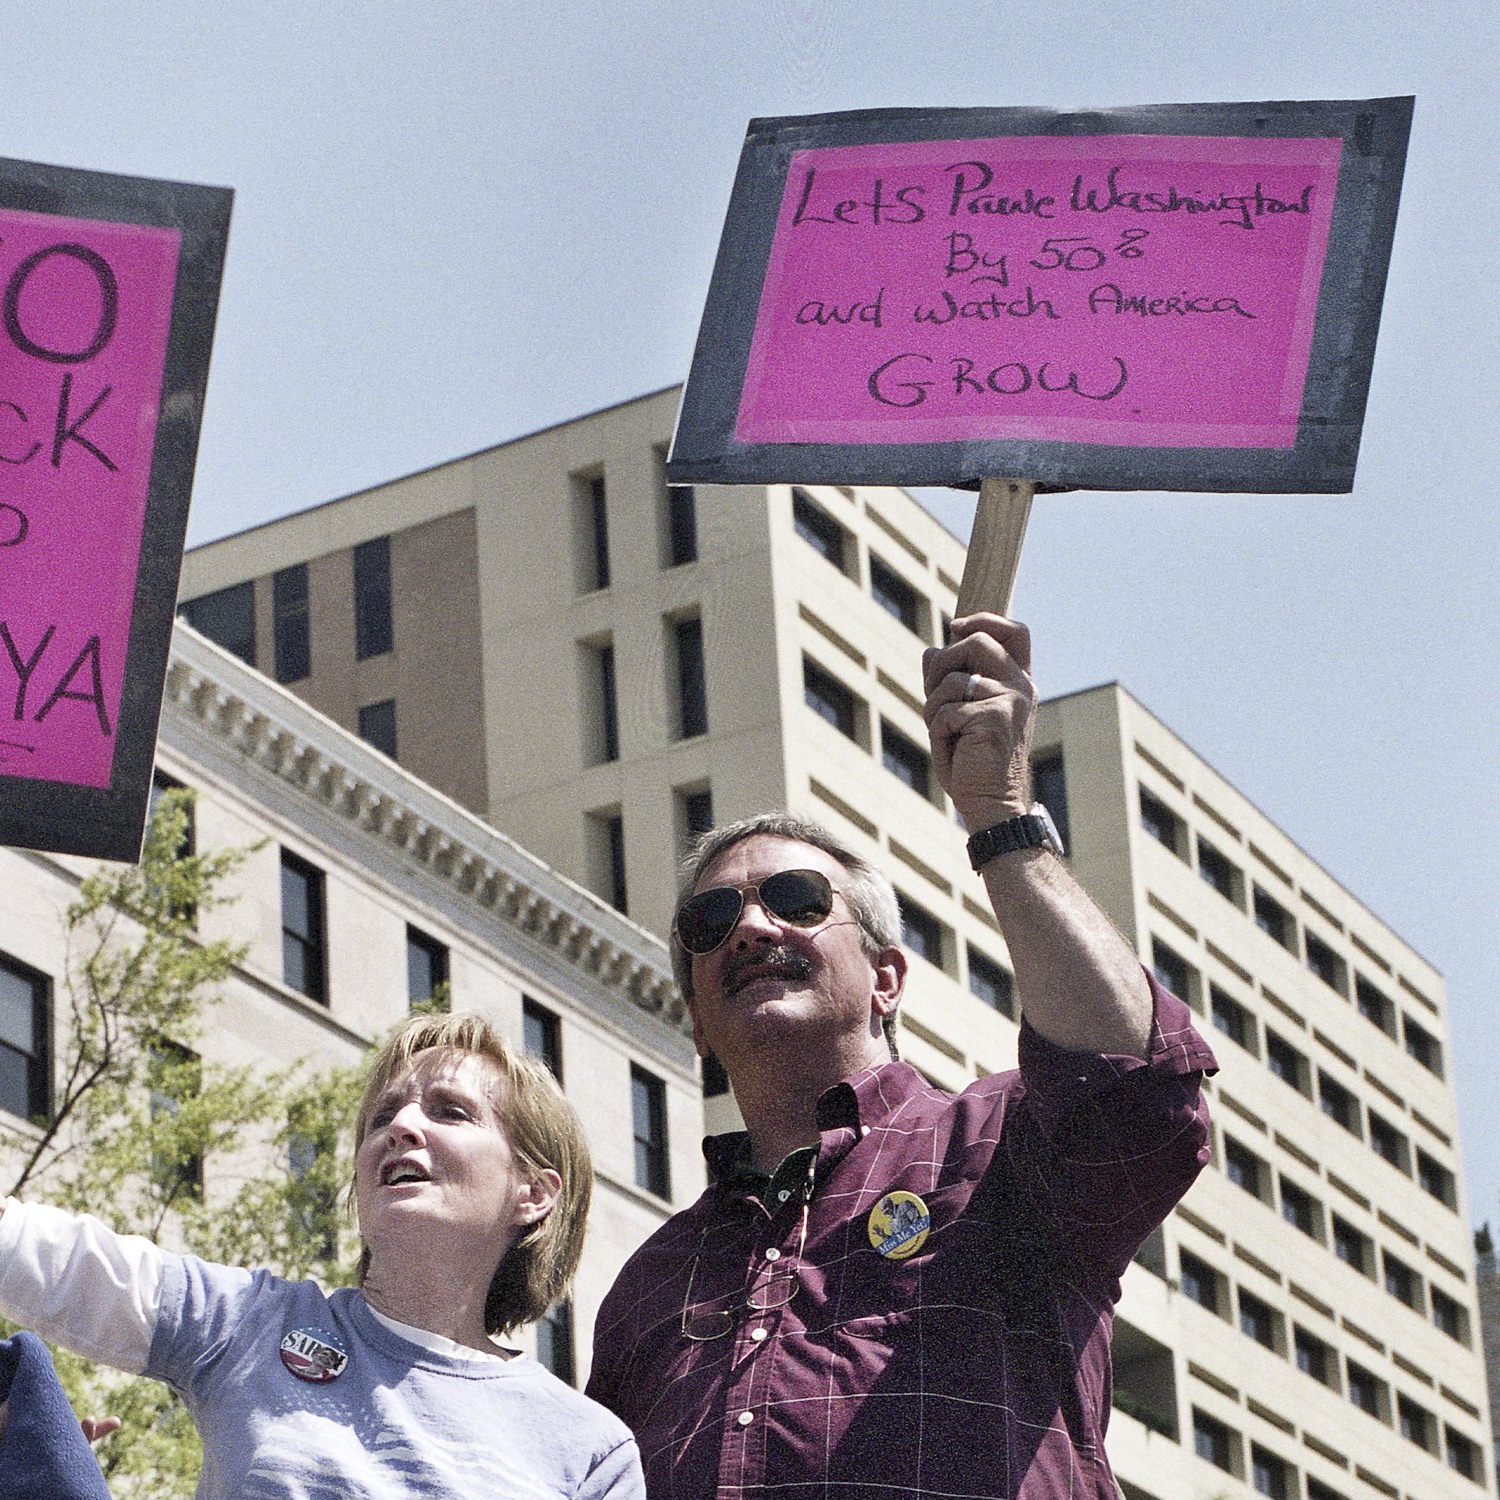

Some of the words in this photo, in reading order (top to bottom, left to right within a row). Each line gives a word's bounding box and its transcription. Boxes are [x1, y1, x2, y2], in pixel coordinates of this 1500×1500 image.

[943, 160, 1056, 218] Prune
[1070, 165, 1316, 230] Washington
[943, 230, 1010, 287] By
[793, 288, 886, 329] and
[867, 352, 1128, 408] GROW
